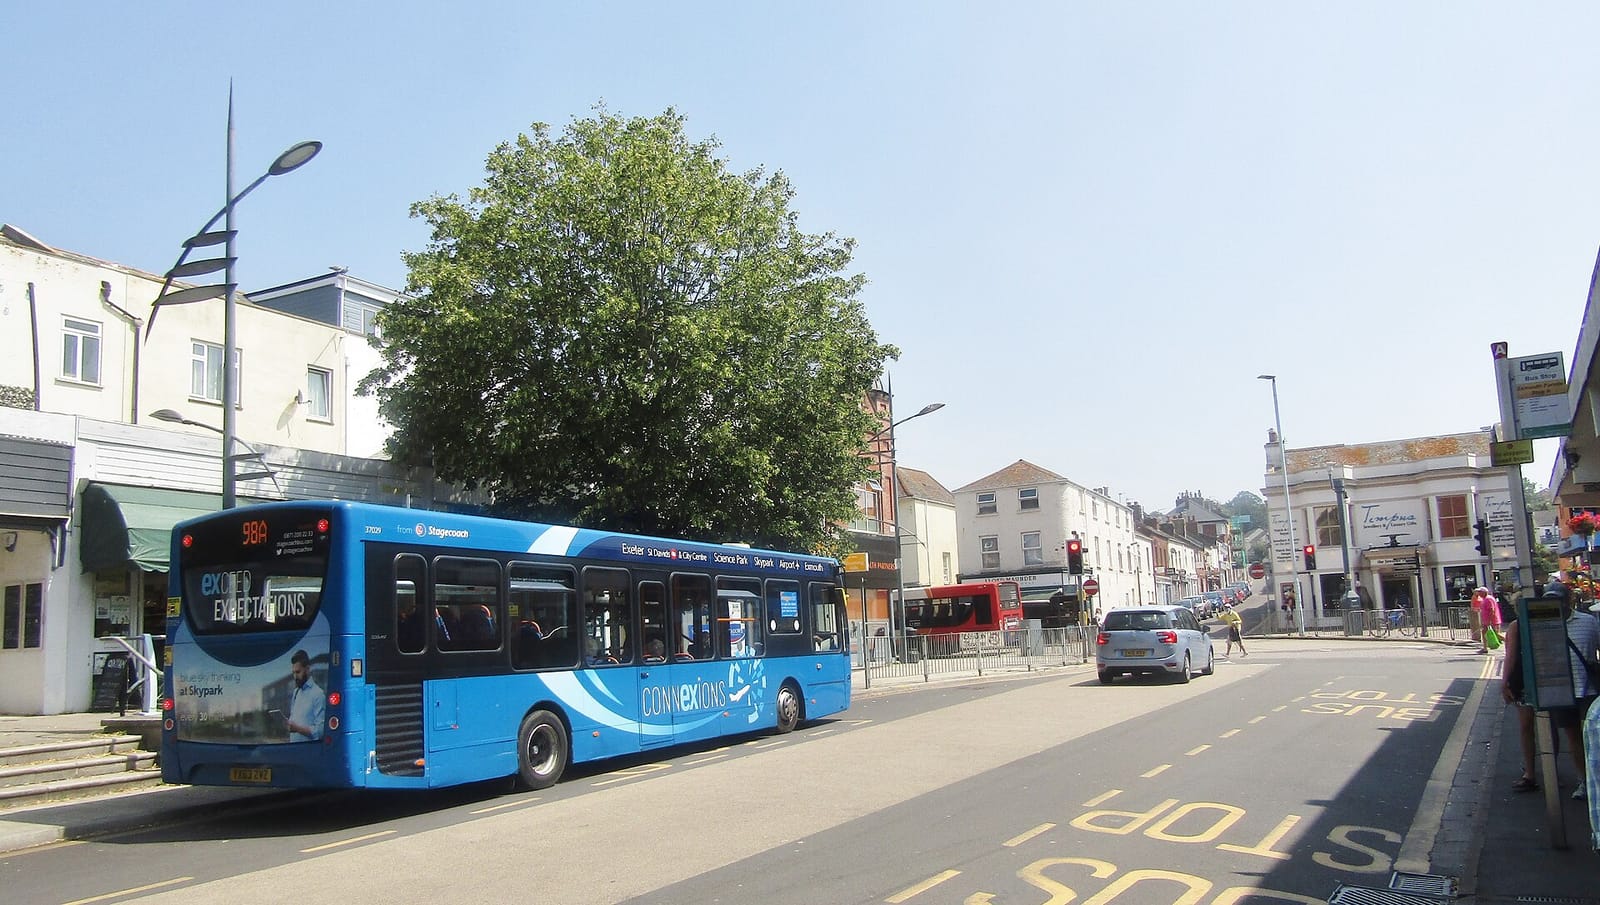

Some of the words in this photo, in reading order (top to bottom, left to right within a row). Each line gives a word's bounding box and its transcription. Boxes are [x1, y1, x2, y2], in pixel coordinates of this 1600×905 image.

[1495, 344, 1506, 355] A
[1361, 504, 1416, 530] Tempus
[242, 520, 268, 545] 98A
[397, 525, 413, 534] from
[428, 526, 469, 538] Stagecoach
[622, 543, 645, 556] Exeter
[647, 548, 653, 557] St
[654, 549, 671, 558] Davids
[683, 551, 692, 561] City
[693, 552, 707, 561] Centre
[713, 552, 736, 564] Science
[737, 554, 748, 565] Park
[754, 556, 775, 568] Skypark
[780, 560, 795, 571] Airport
[804, 562, 824, 572] Exmouth
[179, 687, 188, 696] at
[189, 684, 223, 698] Skypark
[1309, 690, 1466, 706] STOP
[199, 711, 208, 721] 30
[1301, 702, 1443, 723] BUS
[1069, 798, 1402, 873] STOP
